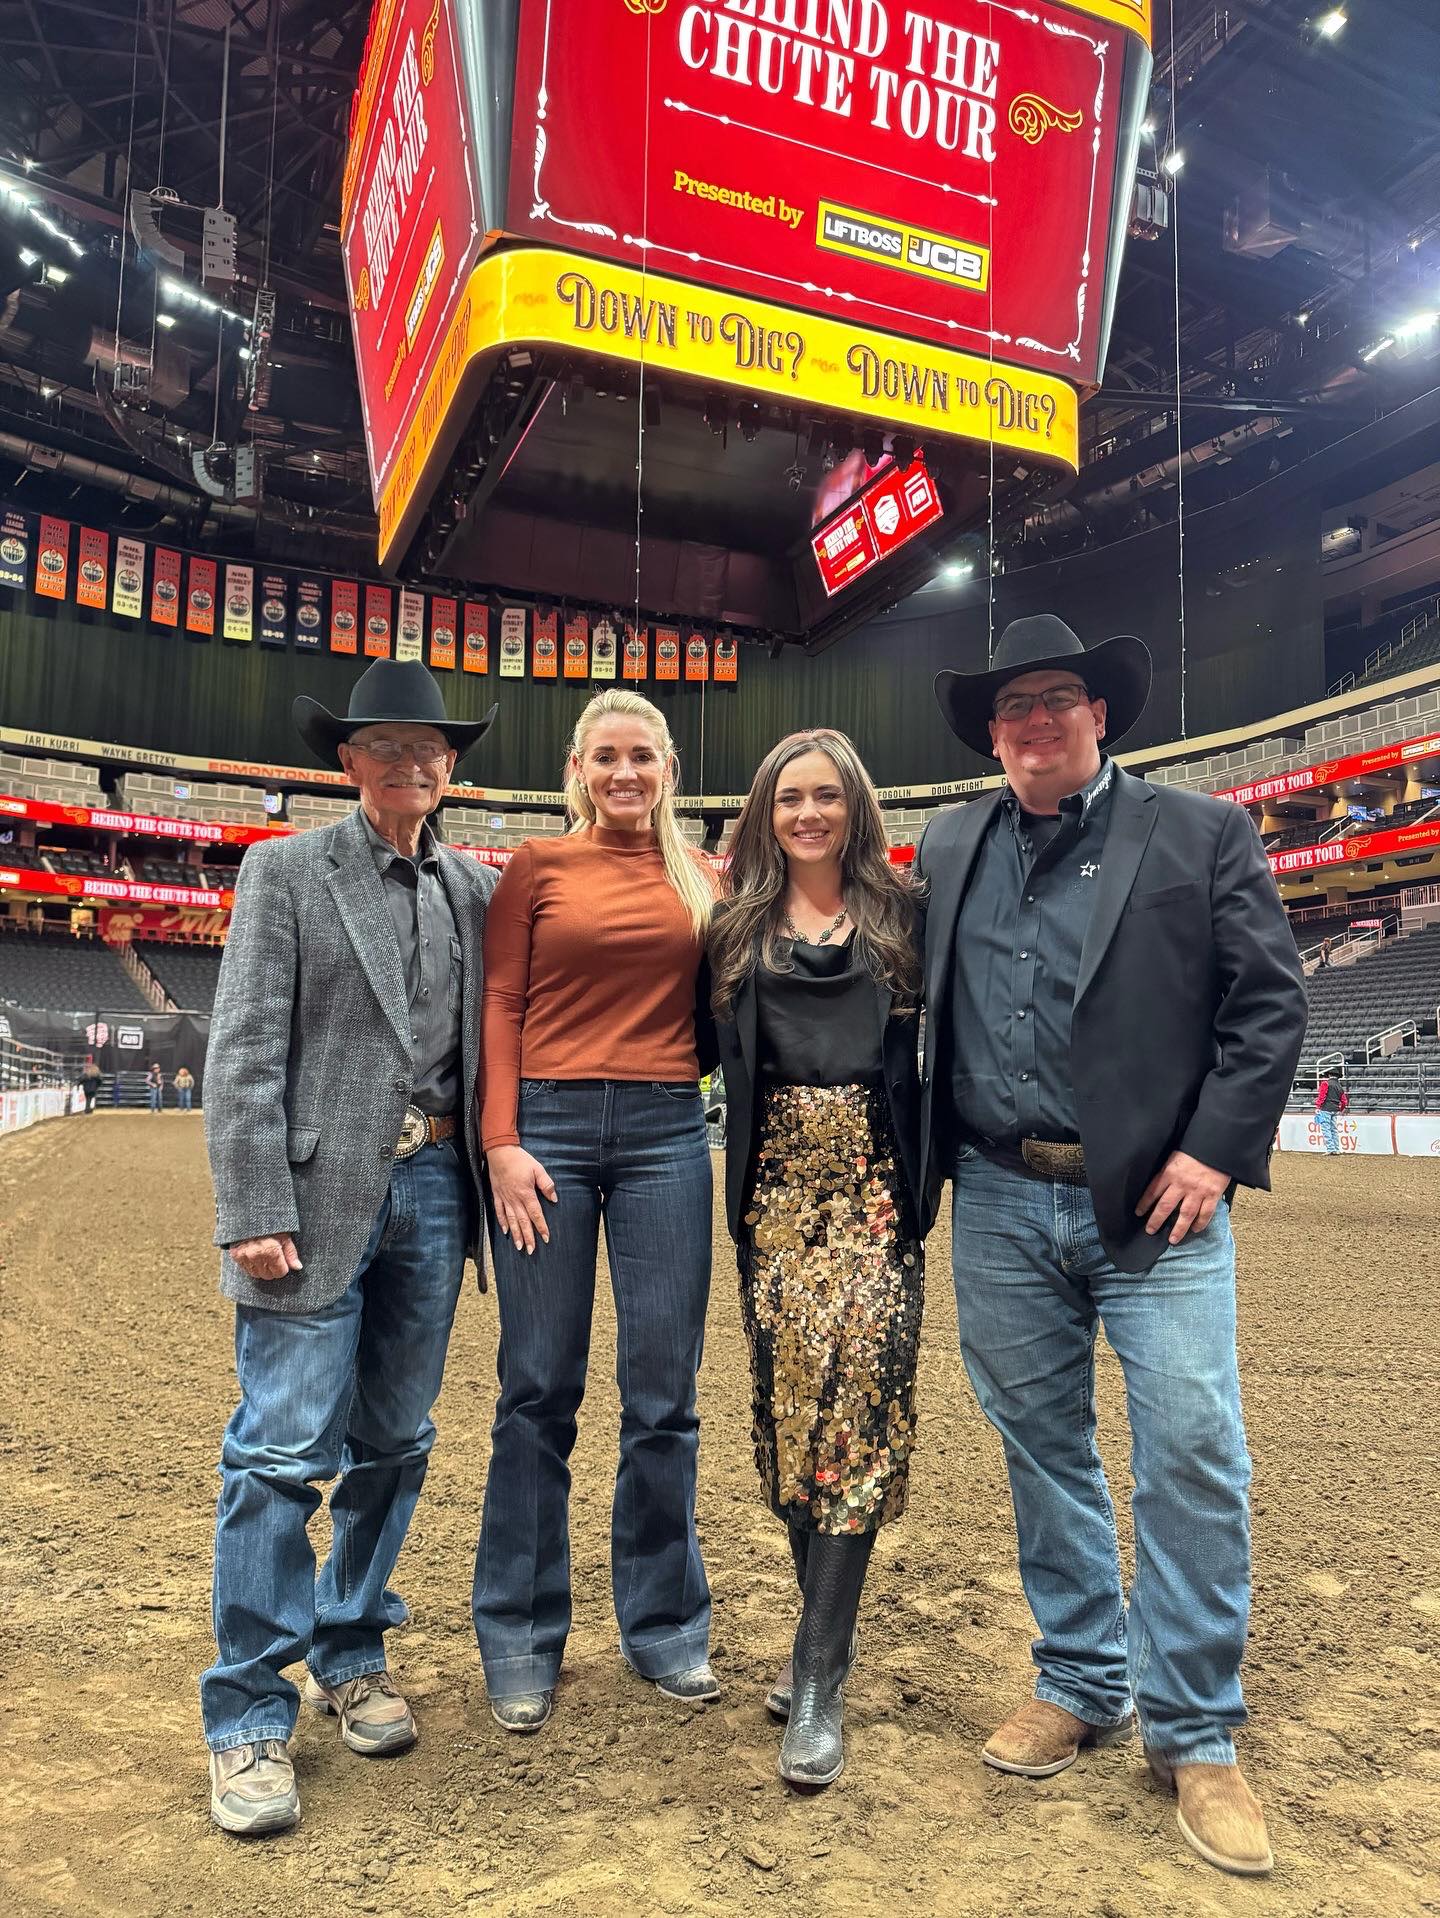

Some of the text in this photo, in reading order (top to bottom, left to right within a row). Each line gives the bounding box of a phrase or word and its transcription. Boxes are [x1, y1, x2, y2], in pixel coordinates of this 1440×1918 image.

[903, 10, 1000, 101] THE
[393, 28, 419, 144] THE
[678, 5, 997, 163] CHUTE TOUR
[370, 90, 429, 311] CHUTE TOUR
[672, 170, 804, 229] Presented by
[824, 216, 902, 255] LIFTBOSS
[908, 240, 982, 281] JCB
[556, 271, 806, 381] DOWN TO DIG?
[846, 343, 1057, 439] DOWN TO DIG?
[25, 734, 80, 751] JARI KURRI
[102, 746, 177, 767] WAYNE GRETZKY
[1362, 753, 1391, 766] Presented
[208, 761, 350, 785] EDMONTON OILE
[442, 788, 485, 800] FAME
[877, 789, 912, 799] FOGOLIN
[932, 780, 984, 795] DOUG WEIGHT
[1235, 786, 1254, 803] THE
[1255, 778, 1286, 798] CHUTE
[1287, 771, 1313, 789] TOUR
[512, 793, 533, 803] MARK
[684, 799, 704, 807] FUHR
[722, 799, 740, 807] GLEN
[91, 812, 133, 827] BEHIND
[134, 817, 157, 832] THE
[1398, 830, 1431, 842] Presented
[1279, 849, 1313, 870] CHUTE
[1314, 843, 1344, 864] TOUR
[129, 885, 152, 899] THE
[1308, 1120, 1349, 1133] dict
[1308, 1134, 1357, 1151] engy
